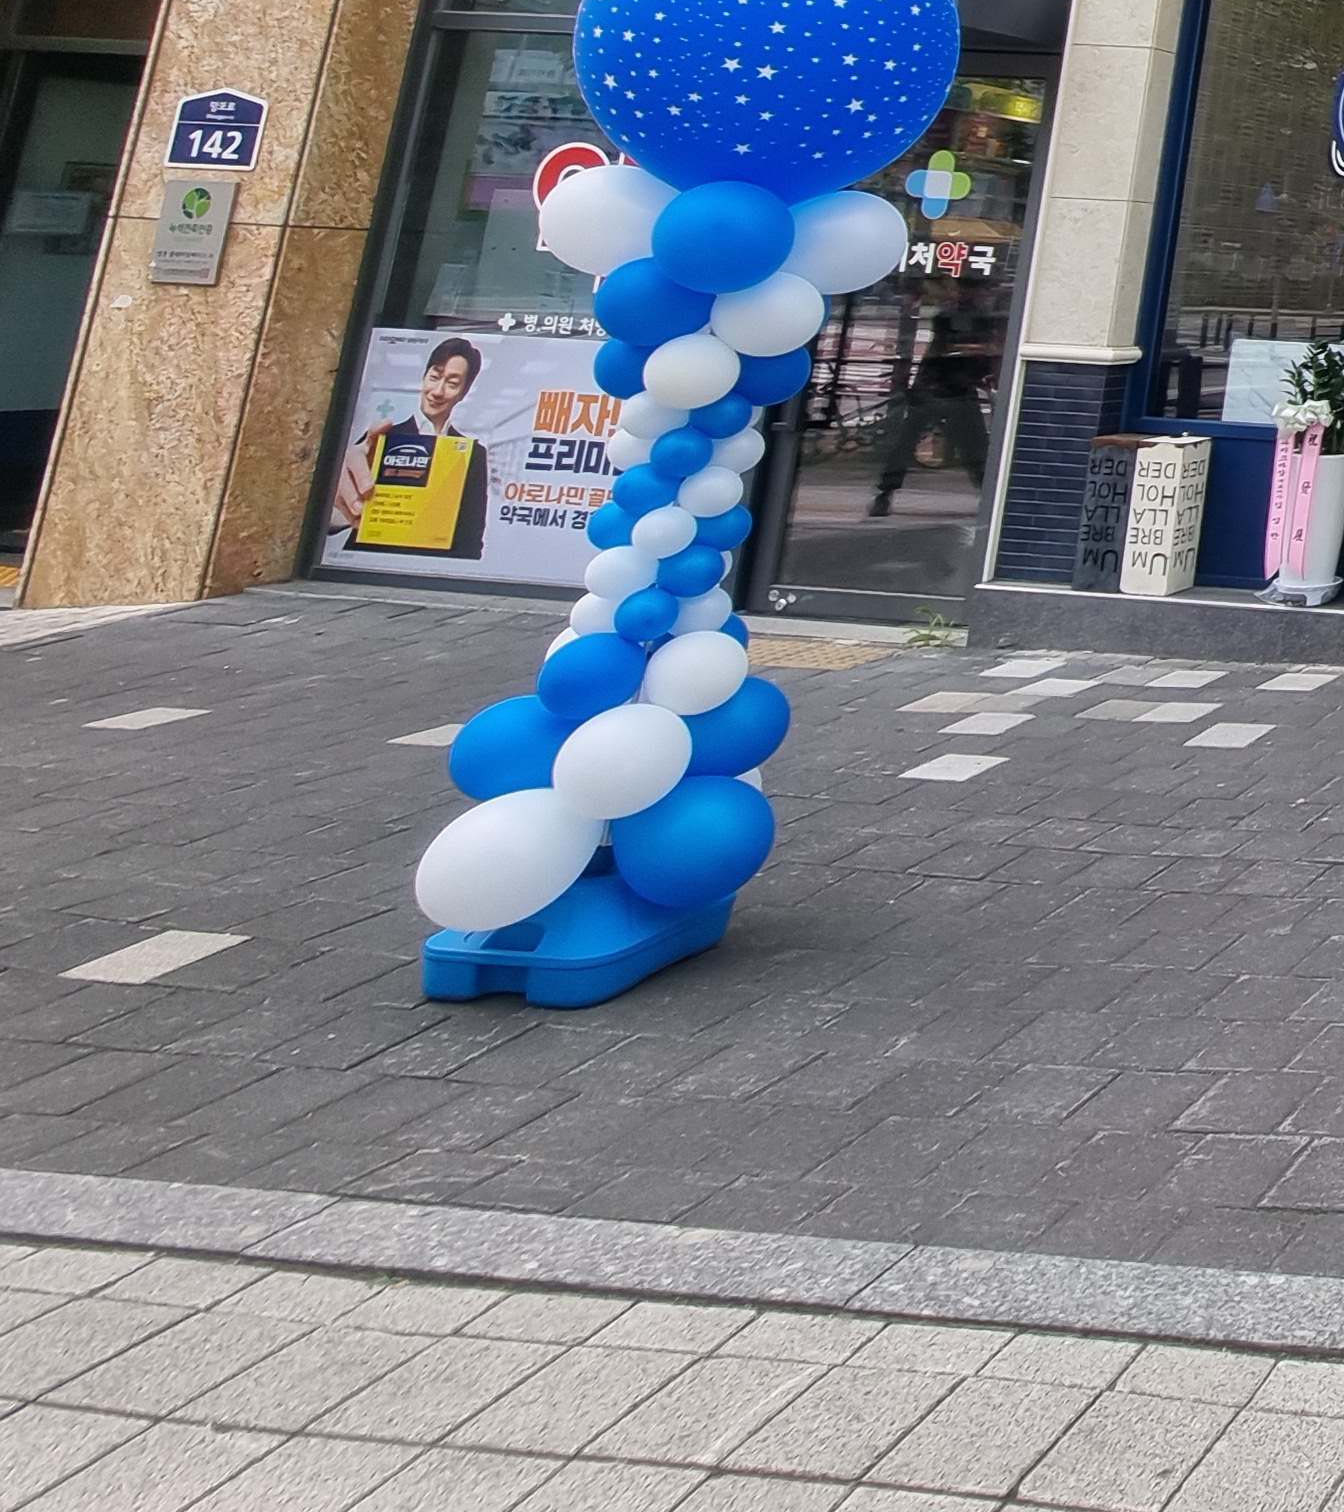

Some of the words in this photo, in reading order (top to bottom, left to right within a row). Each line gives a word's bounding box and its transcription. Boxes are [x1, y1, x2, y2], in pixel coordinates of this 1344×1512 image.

[189, 129, 243, 160] 142
[523, 314, 574, 335] 병.의원
[533, 391, 622, 438] 빼자!
[525, 437, 624, 476] 프리미
[1138, 461, 1176, 479] DER
[504, 482, 585, 506] 아로나민
[588, 488, 612, 507] 골
[1136, 484, 1177, 507] HOL
[499, 505, 567, 528] 약국에서
[1133, 508, 1169, 526] LLA
[1129, 527, 1164, 545] BRE
[1131, 551, 1168, 576] UM
